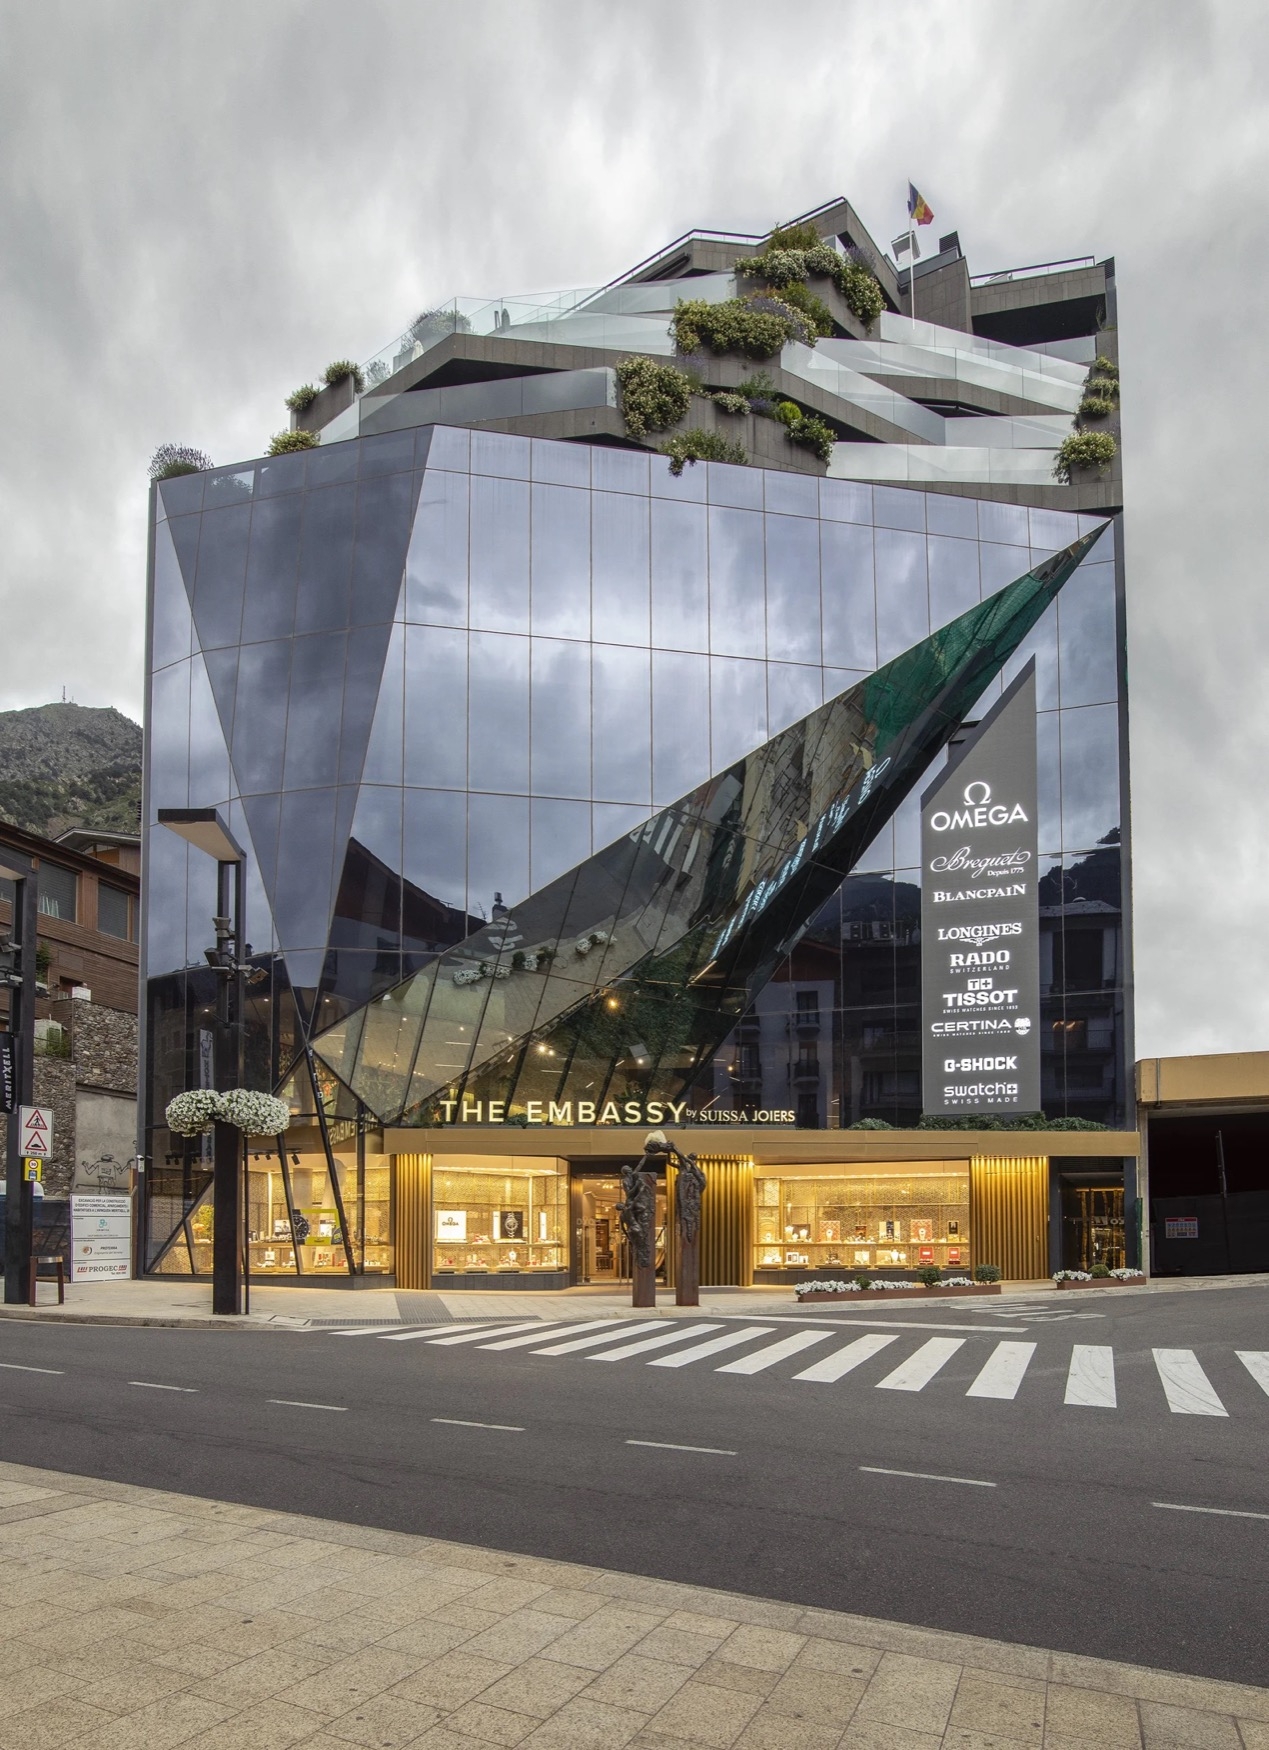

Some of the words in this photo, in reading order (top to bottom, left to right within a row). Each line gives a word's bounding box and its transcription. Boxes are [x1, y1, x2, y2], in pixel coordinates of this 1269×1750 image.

[930, 803, 1029, 832] OMEGA
[930, 844, 1032, 879] Breguet
[987, 869, 1010, 878] Depuis
[1011, 866, 1025, 875] 1775
[933, 883, 1027, 903] BLANCPAIN
[938, 922, 1023, 941] LONGINES
[950, 950, 1010, 967] RADO
[950, 965, 1010, 974] SWITZERLAND
[943, 989, 1018, 1008] TISSOT
[931, 1019, 1012, 1033] CERTINA
[944, 1055, 1018, 1073] G-SHOCK
[2, 1047, 13, 1110] MERITXELL
[944, 1082, 1006, 1097] swatch
[987, 1096, 1018, 1104] MADE
[439, 1100, 505, 1123] THE
[527, 1100, 687, 1123] EMBASSY
[686, 1107, 697, 1119] by
[699, 1109, 749, 1123] SUISSA
[751, 1109, 796, 1123] JOIERS
[89, 1265, 118, 1273] PROGEC
